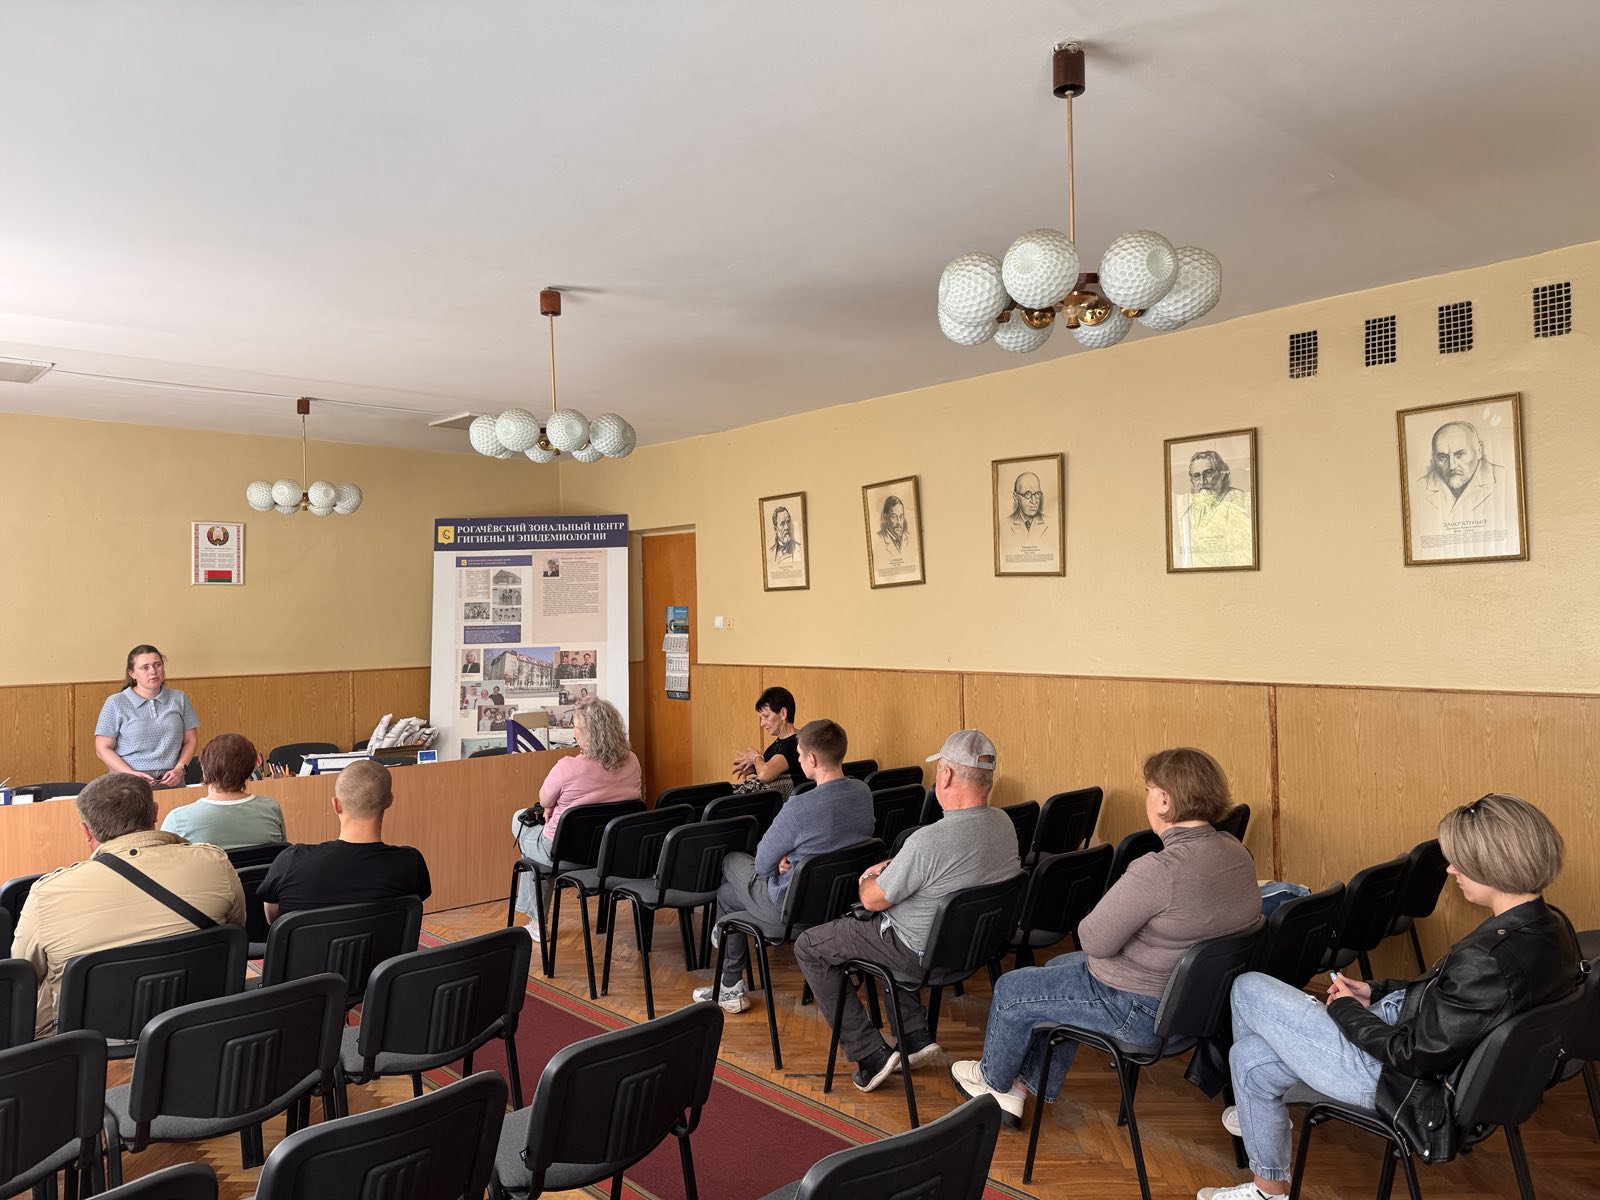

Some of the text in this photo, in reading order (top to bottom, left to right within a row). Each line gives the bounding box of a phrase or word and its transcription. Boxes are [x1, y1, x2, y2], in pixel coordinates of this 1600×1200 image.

[457, 522, 625, 534] РОГАЧЁВСКИЙ ЗОНАЛЬНЫЙ ЦЕНТР
[457, 533, 607, 543] ГИГИЕНЫ И ЭПИДЕМИОЛОГИИ
